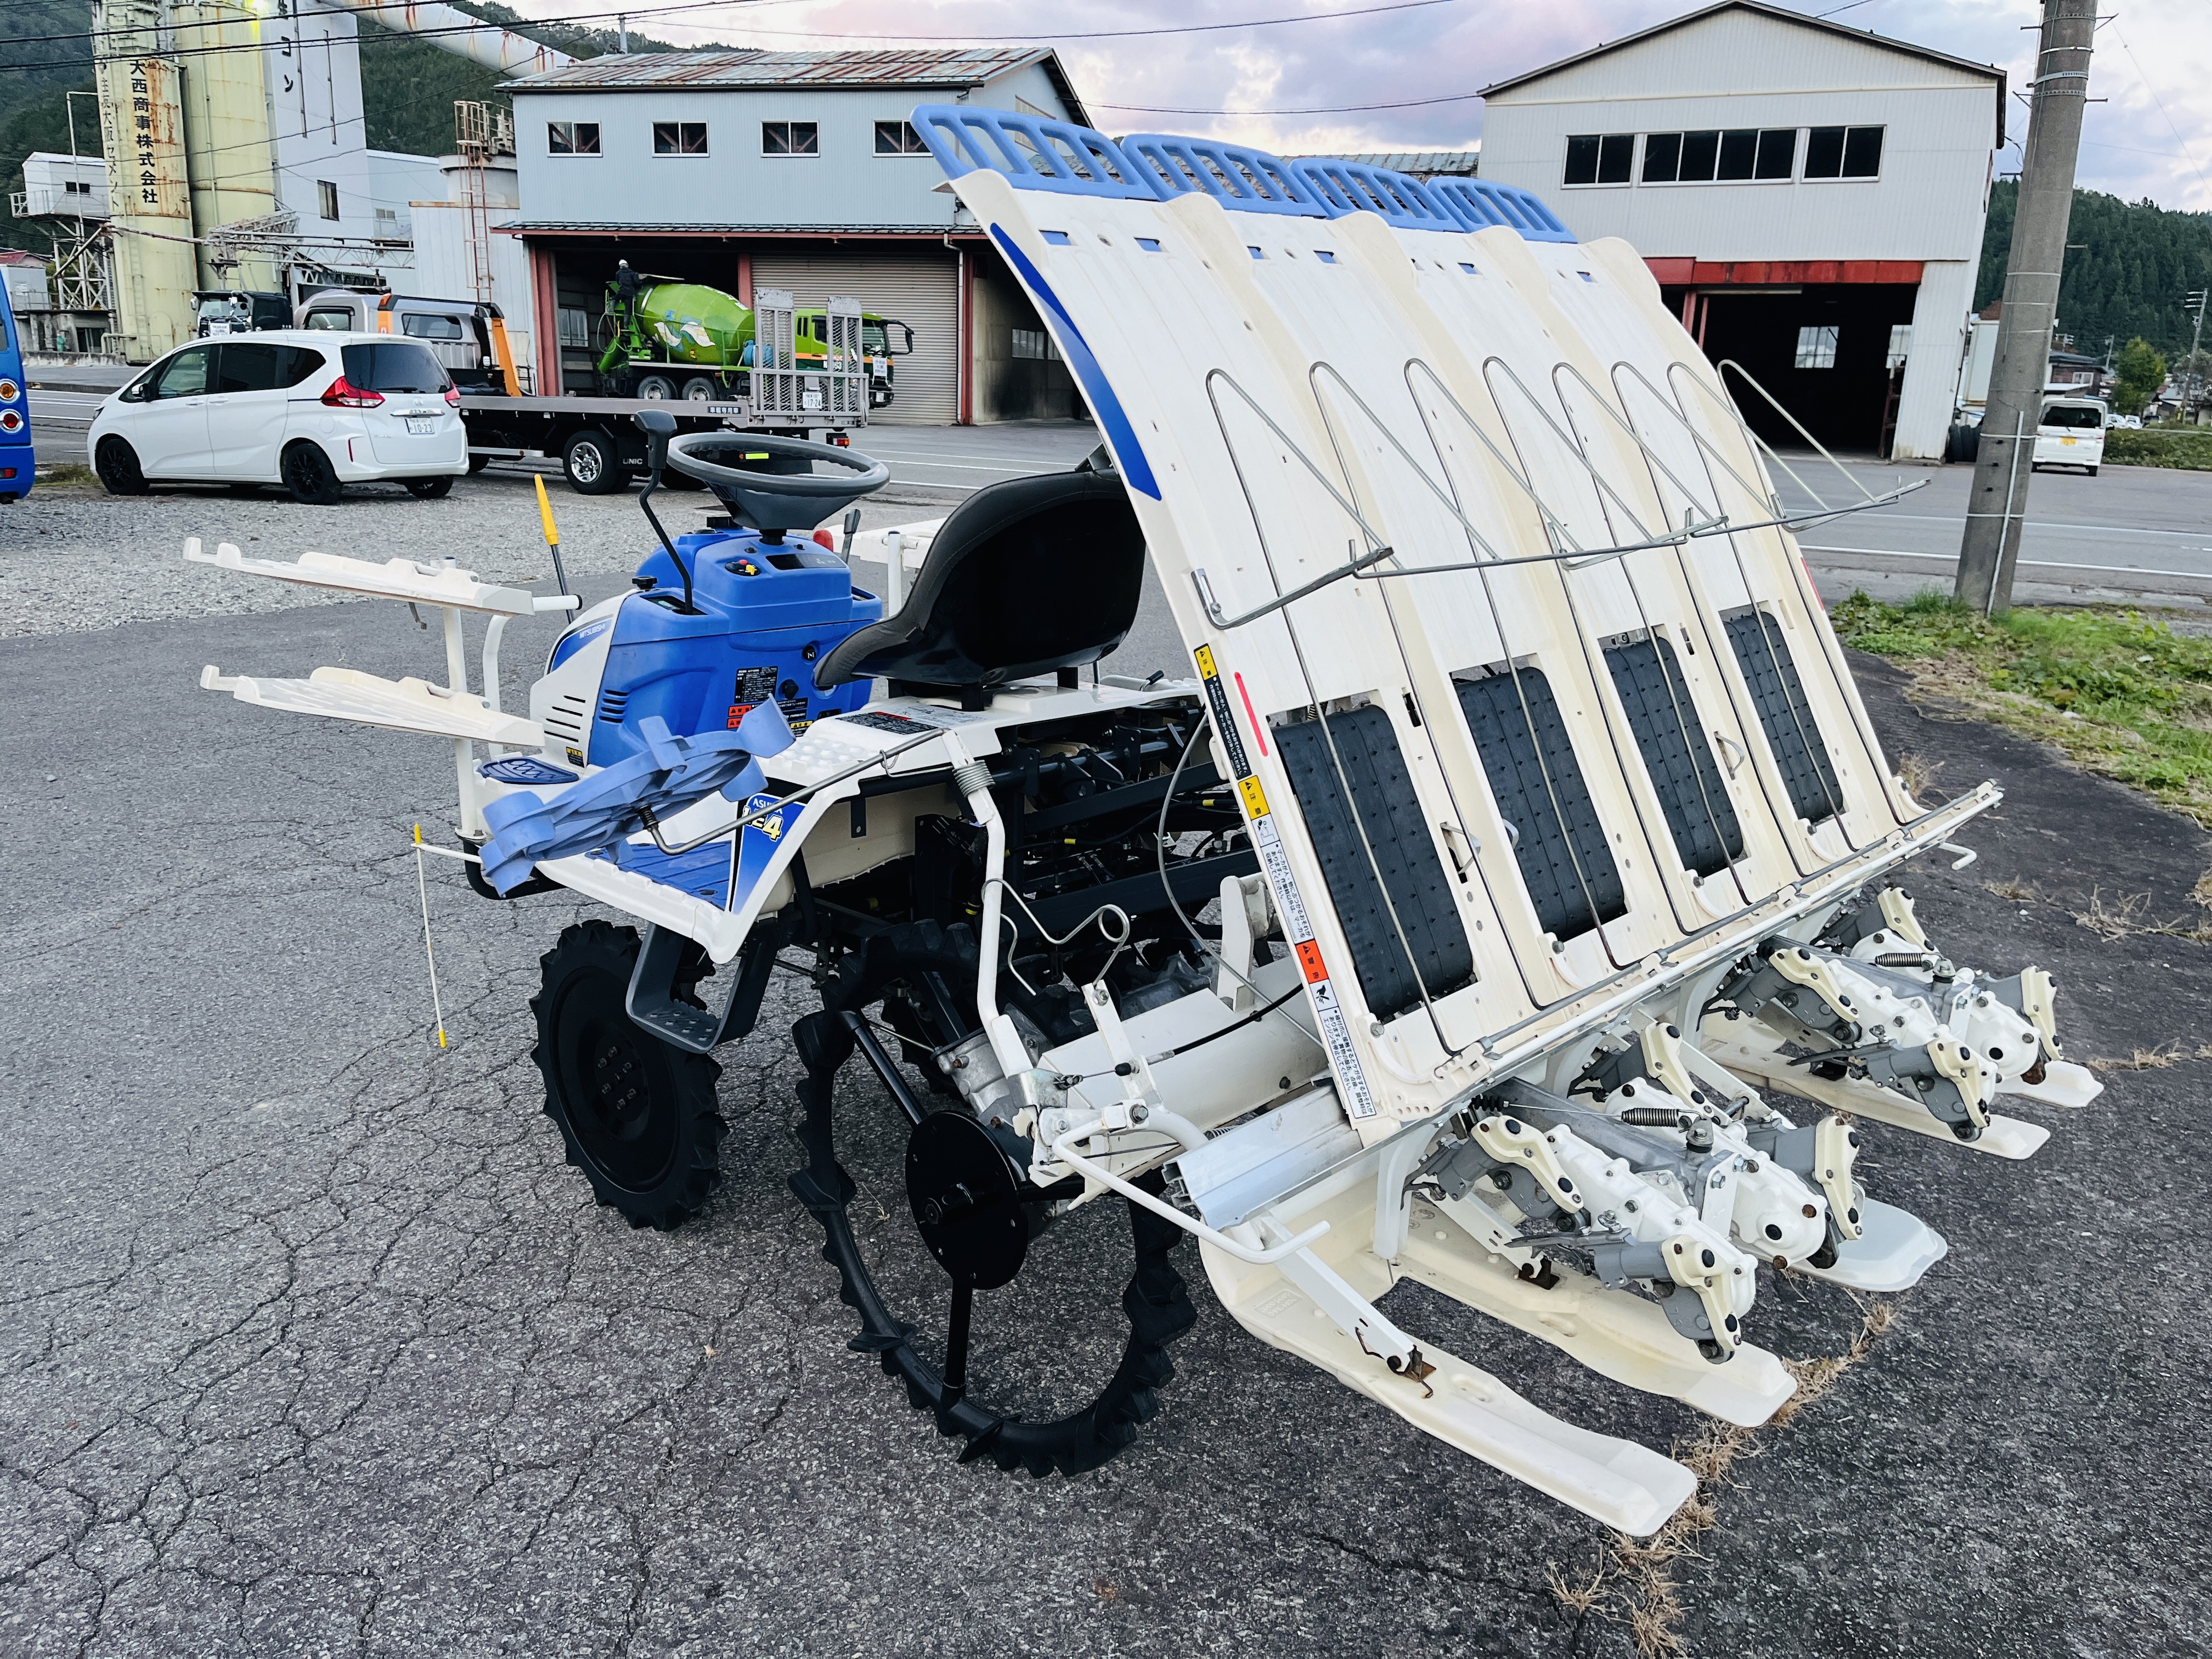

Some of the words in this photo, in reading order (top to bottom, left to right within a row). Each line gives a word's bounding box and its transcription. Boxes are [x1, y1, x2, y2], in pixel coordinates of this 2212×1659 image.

[129, 59, 159, 204] 大西商事株式会社
[579, 623, 606, 639] MITSUBISHI
[753, 798, 783, 814] ASUA
[1249, 792, 1262, 815] 注意
